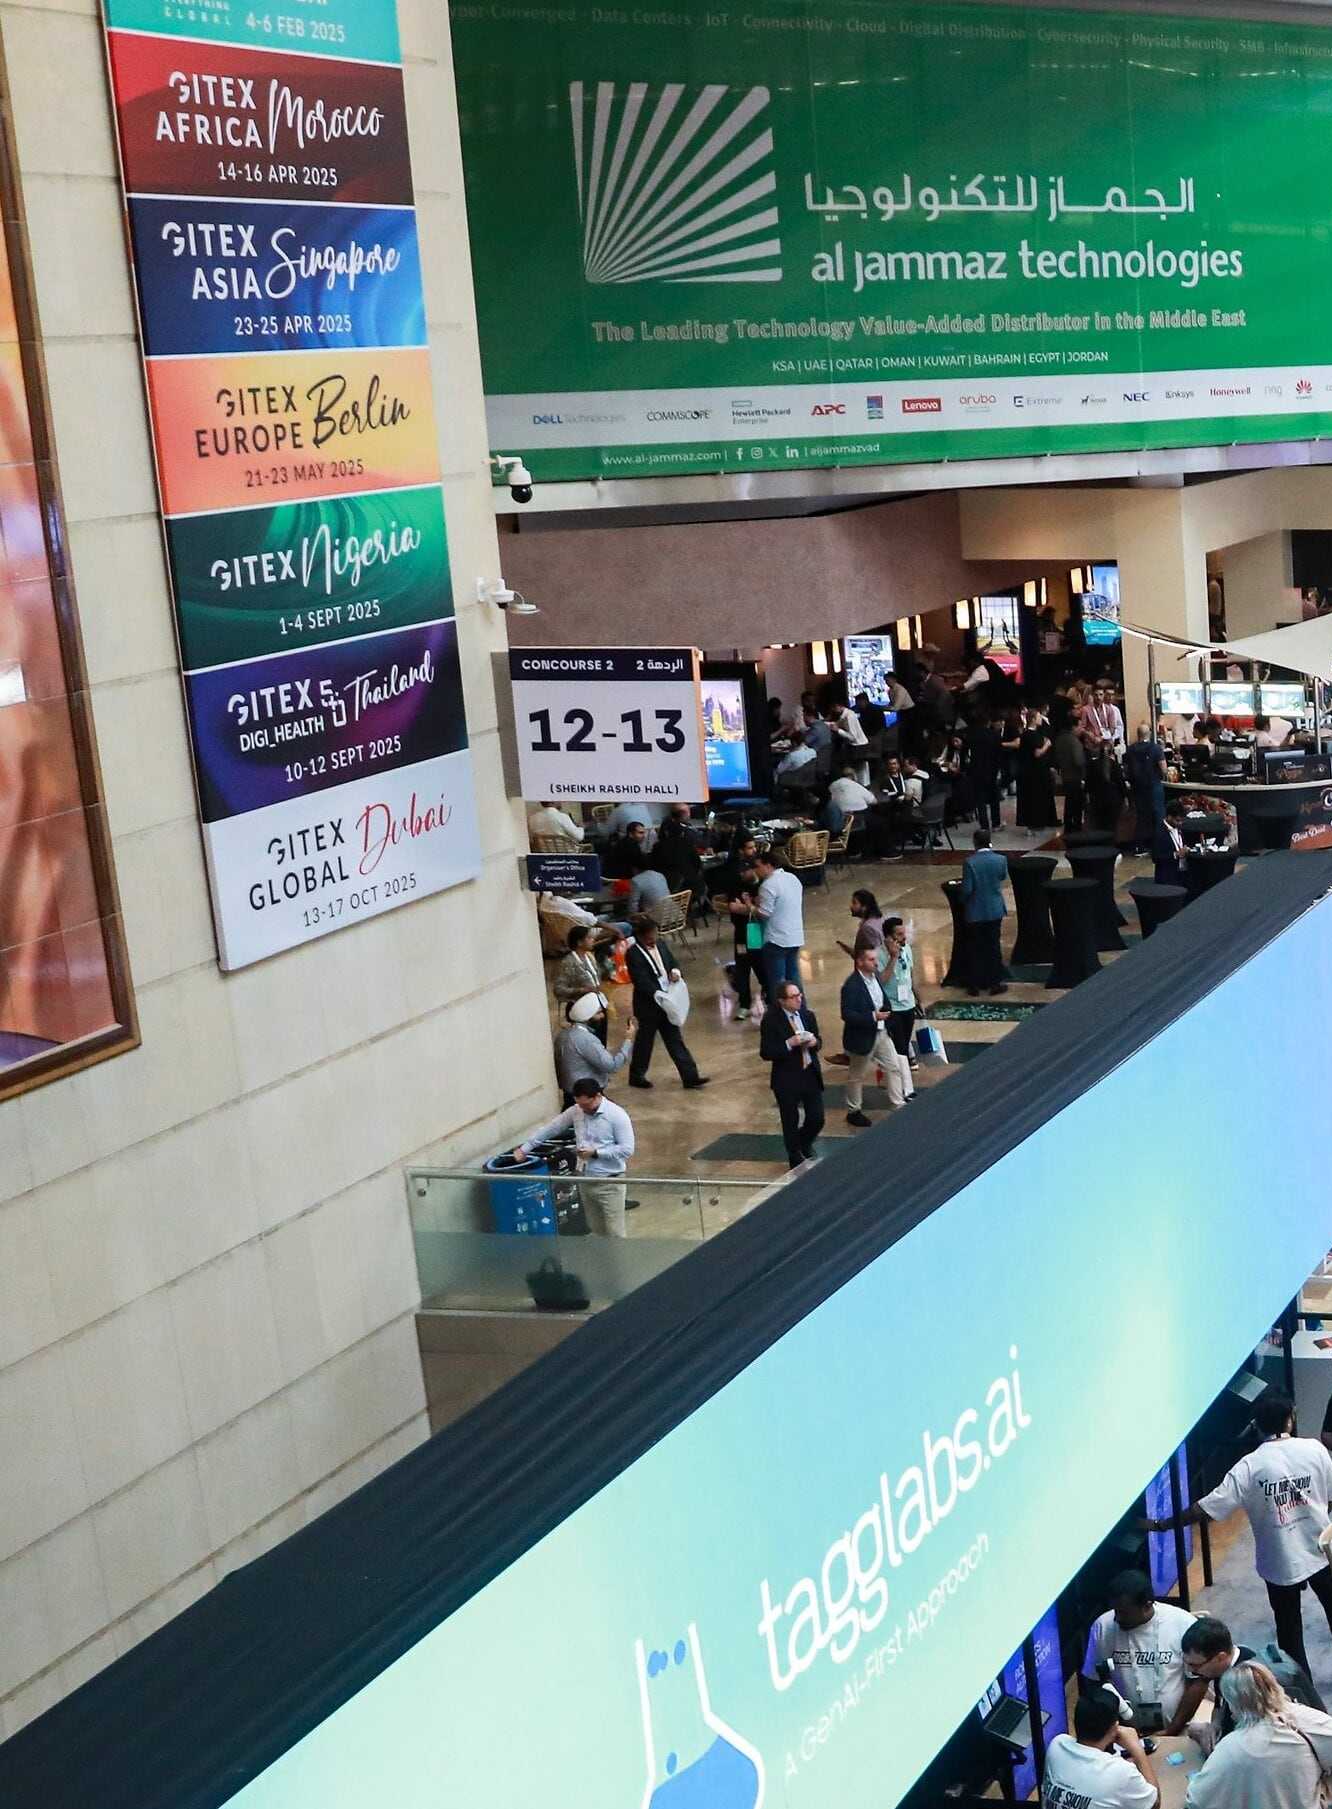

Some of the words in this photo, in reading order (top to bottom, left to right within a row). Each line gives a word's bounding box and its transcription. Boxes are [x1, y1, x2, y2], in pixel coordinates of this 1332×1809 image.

[169, 71, 257, 110] GITEX
[156, 111, 263, 149] AFRICA
[268, 78, 385, 155] Morocco
[218, 161, 262, 182] 14-16
[268, 164, 298, 184] APR
[303, 167, 338, 187] 2025
[804, 173, 1038, 221] للتكنولوجيا
[161, 221, 258, 257] GITEX
[265, 228, 401, 299] Singapore
[811, 241, 845, 282] al
[853, 249, 1007, 293] jammaz
[1019, 240, 1243, 288] technologies
[191, 267, 263, 300] ASIA
[234, 316, 278, 335] 23-25
[284, 315, 313, 334] APR
[318, 314, 351, 333] 2025
[592, 320, 634, 342] The
[641, 319, 728, 344] Leading
[733, 315, 855, 342] Technology
[859, 312, 985, 336] Value-Added
[991, 311, 1091, 332] Distributor
[1094, 312, 1111, 330] in
[1114, 310, 1144, 330] the
[1149, 310, 1206, 329] Middle
[1211, 309, 1246, 327] East
[835, 359, 873, 370] QATAR
[974, 353, 1021, 365] BAHRAIN
[1067, 351, 1109, 362] JORDAN
[216, 385, 297, 417] GITEX
[306, 374, 410, 448] Berlin
[195, 422, 303, 458] EUROPE
[246, 467, 288, 487] 21-23
[293, 463, 324, 481] MAY
[331, 458, 364, 478] 2025
[210, 550, 296, 591] GITEX
[302, 521, 421, 595] Nigeria
[279, 615, 303, 635] 1-4
[308, 606, 342, 630] SEPT
[348, 599, 381, 622] 2025
[522, 659, 602, 671] CONCOURSE
[647, 659, 684, 673] الردهة
[227, 678, 313, 726] GITEX
[344, 650, 435, 722] Thailand
[240, 715, 324, 753] DIGI_HEALTH
[529, 708, 685, 753] 12-13
[285, 756, 327, 783] 10-12
[331, 747, 365, 770] SEPT
[369, 735, 402, 759] 2025
[599, 784, 641, 794] RASHID
[267, 818, 345, 865] GITEX
[355, 792, 452, 876] Dubai
[249, 856, 349, 911] GLOBAL
[303, 899, 344, 927] 13-17
[350, 885, 378, 910] OCT
[385, 872, 417, 899] 2025
[1264, 1483, 1277, 1496] LET
[758, 1344, 1032, 1692] tagglabs.ai
[905, 1532, 990, 1645] Approach
